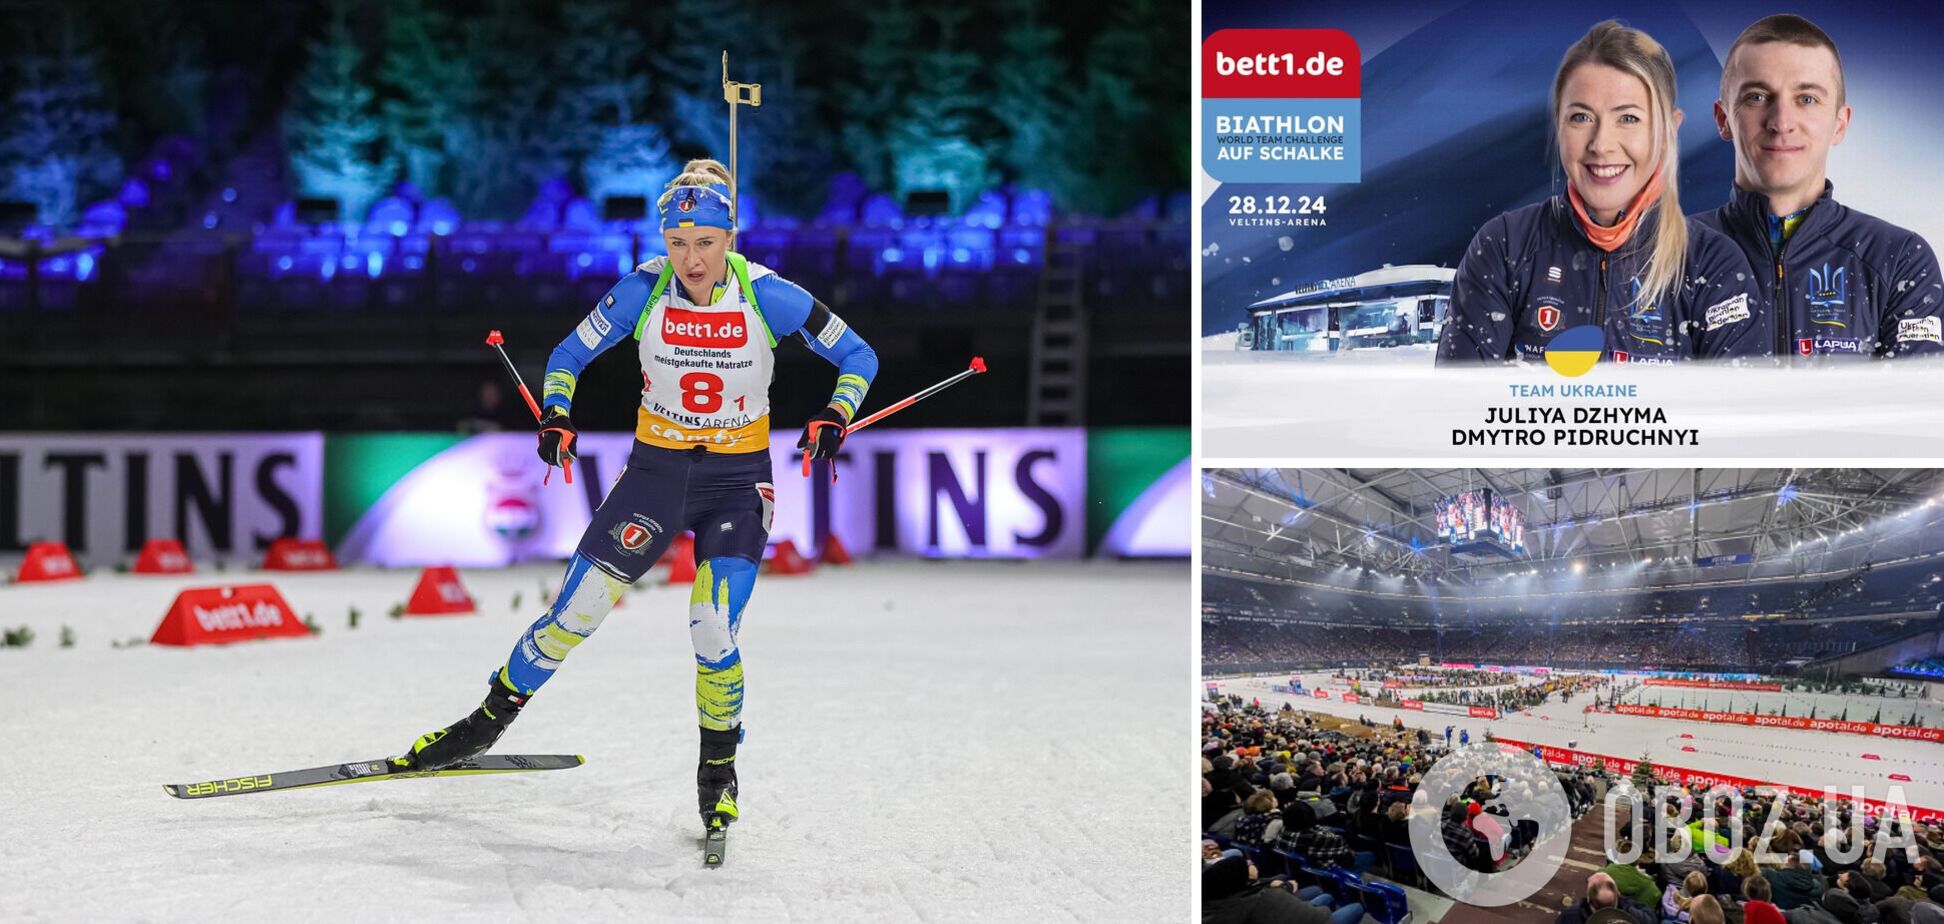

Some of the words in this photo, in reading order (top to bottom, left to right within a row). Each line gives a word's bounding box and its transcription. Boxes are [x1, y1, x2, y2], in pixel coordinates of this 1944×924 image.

[1216, 51, 1344, 76] bett1.de
[1216, 115, 1344, 134] BIATHLON
[1217, 135, 1253, 144] WORLD
[1257, 135, 1282, 144] TEAM
[1285, 135, 1344, 144] CHALLENGE
[1217, 146, 1253, 160] AUF
[1260, 146, 1344, 160] SCHALKE
[1228, 195, 1327, 214] 28.12.24
[1228, 218, 1327, 226] VELTINS-ARENA
[665, 317, 743, 338] bett1.de
[674, 346, 732, 359] Deutschlands
[1525, 344, 1546, 354] NAF
[1814, 340, 1857, 351] LAPUA
[654, 354, 714, 369] meistgekaufte
[716, 359, 753, 370] Matratze
[679, 371, 725, 414] 8
[1509, 384, 1555, 397] TEAM
[1560, 384, 1637, 397] UKRAINE
[733, 394, 746, 412] 1
[701, 413, 752, 429] ARENA
[1485, 407, 1566, 424] JULIYA
[1574, 407, 1667, 424] DZHYMA
[1452, 429, 1546, 446] DMYTRO
[1554, 429, 1699, 446] PIDRUCHNYI
[1618, 705, 1655, 715] apotal.de
[1658, 708, 1699, 719] apotal.de
[1703, 712, 1748, 723] apotal.de
[1755, 715, 1805, 729] apotal.de
[1810, 719, 1867, 734] apotal.de
[1872, 725, 1940, 741] apotal.de
[1572, 753, 1620, 769] apotl.de
[1623, 760, 1680, 780] apal.de
[186, 774, 272, 796] FISCHER
